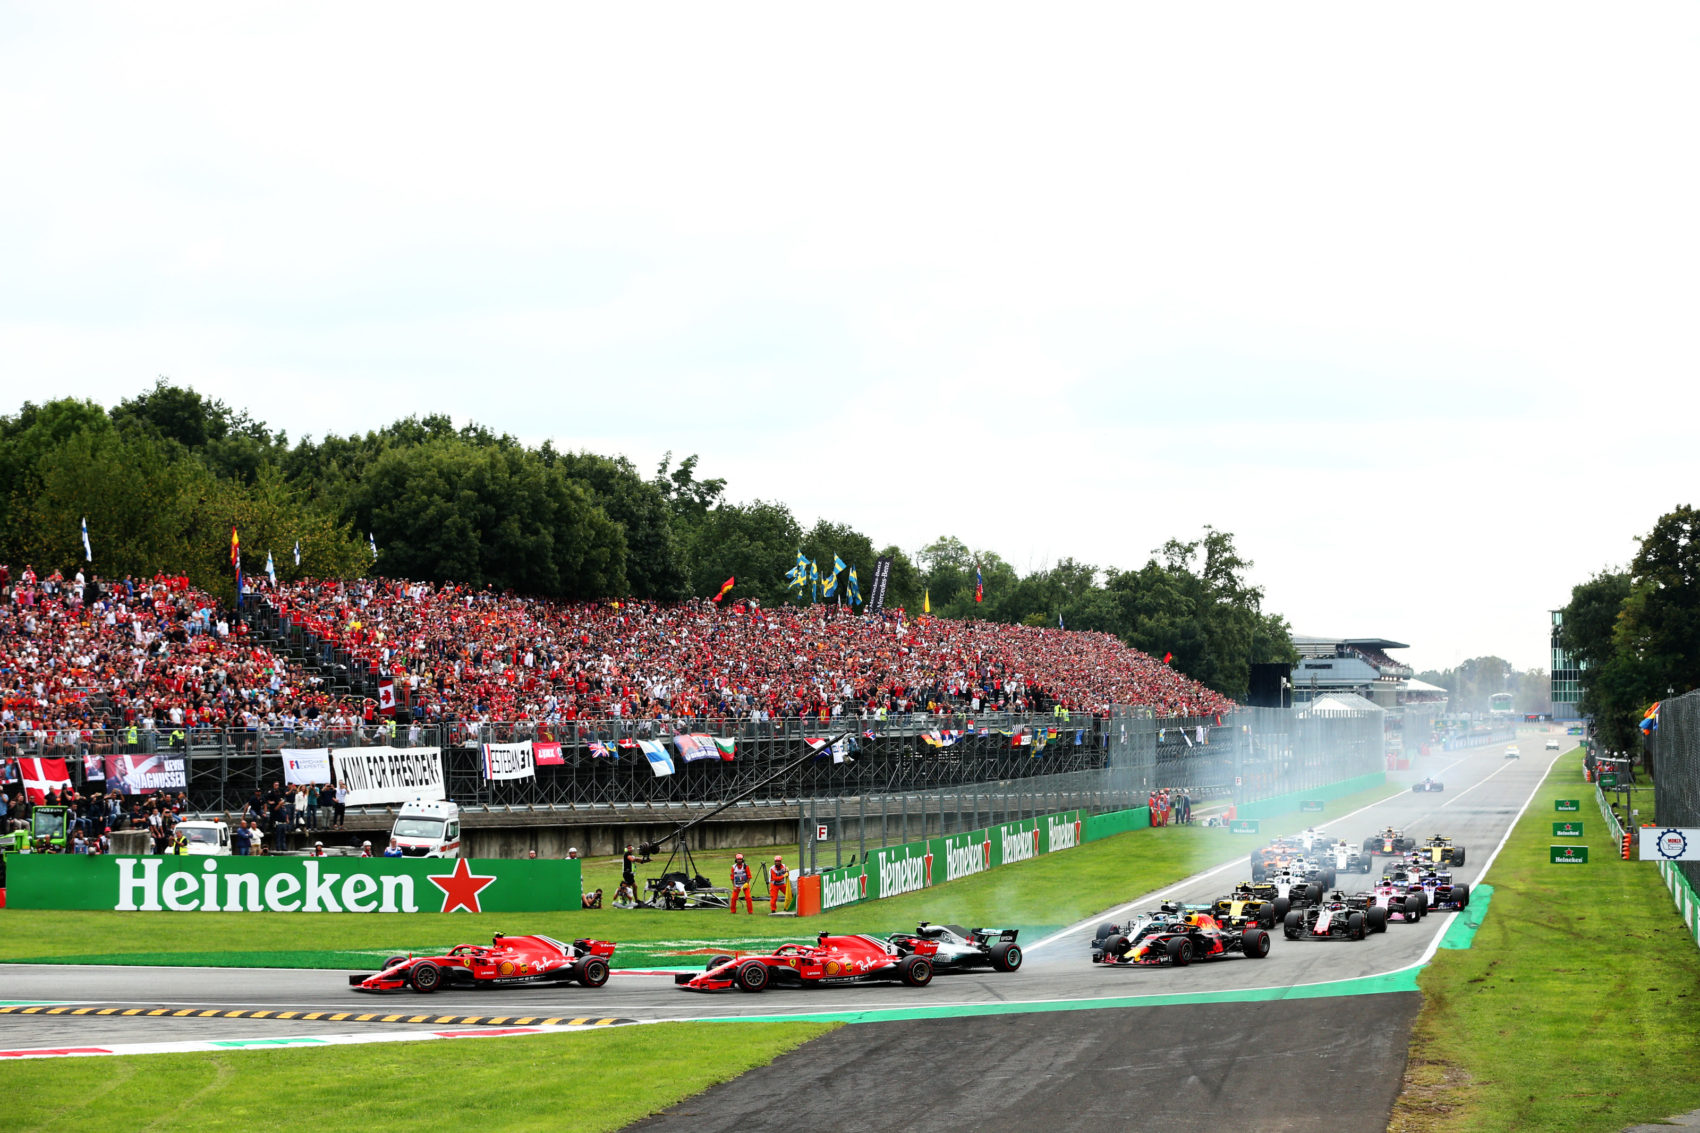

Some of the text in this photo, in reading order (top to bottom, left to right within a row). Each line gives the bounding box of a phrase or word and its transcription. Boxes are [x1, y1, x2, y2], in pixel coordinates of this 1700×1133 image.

[877, 562, 890, 608] Mercedes-Benz
[164, 759, 185, 771] KEVIN
[289, 760, 300, 770] F1
[339, 753, 441, 791] KIMI FOR PRESIDENT
[491, 748, 531, 774] ESTEBAN 31
[818, 826, 827, 839] F
[1001, 823, 1033, 865] Heineken
[1049, 815, 1074, 852] Heineken
[878, 847, 923, 899] Heineken
[946, 835, 983, 881] Heineken
[115, 858, 419, 912] Heineken
[822, 870, 859, 909] Heineken
[564, 946, 569, 956] 7
[886, 944, 892, 954] 5
